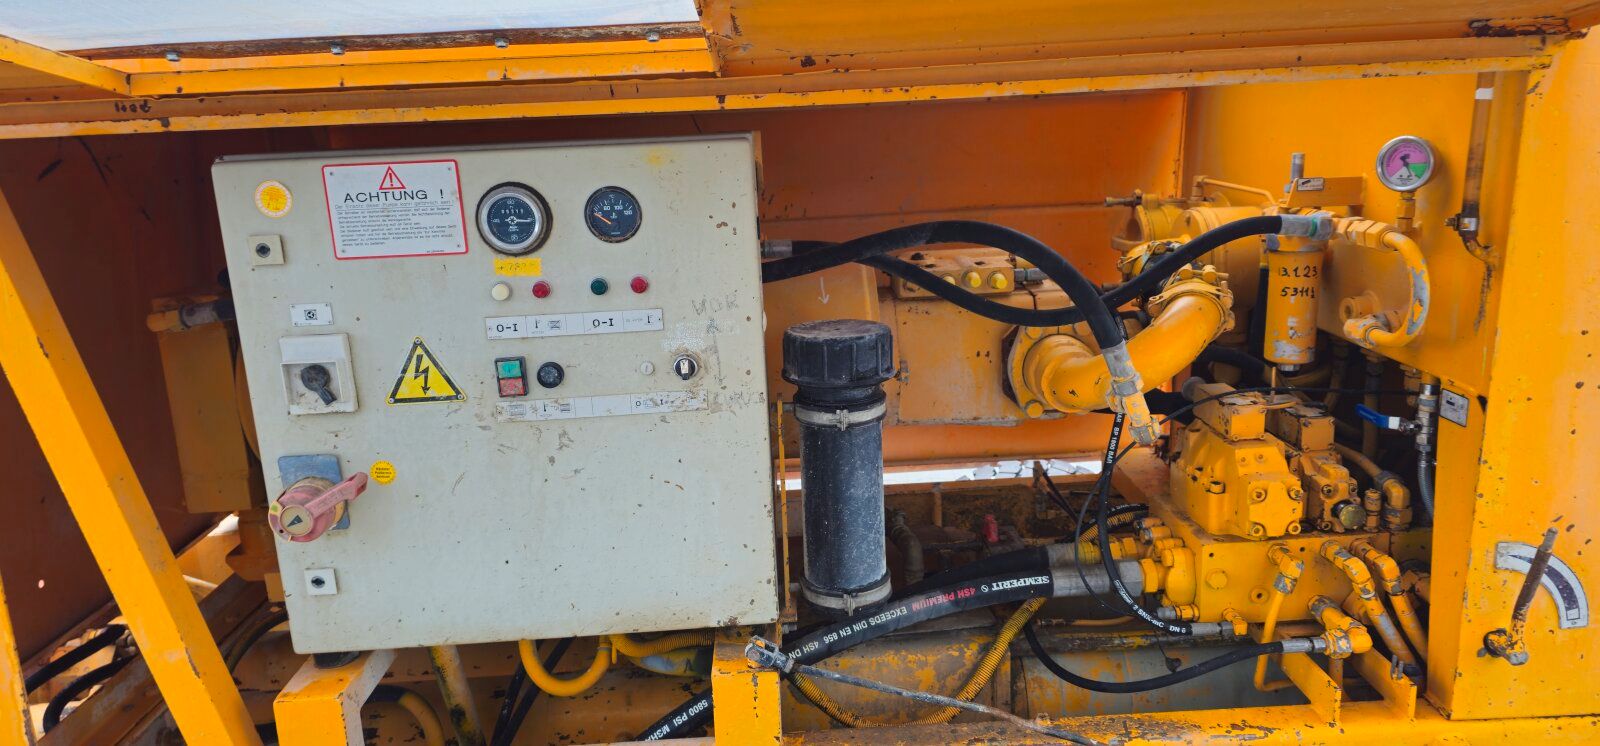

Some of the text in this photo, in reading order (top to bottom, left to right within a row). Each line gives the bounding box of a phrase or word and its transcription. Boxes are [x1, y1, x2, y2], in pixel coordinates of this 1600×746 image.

[344, 188, 444, 203] ACHTUNG !
[991, 575, 1050, 591] SEMPERIT
[957, 587, 977, 599] 4SH
[911, 592, 955, 612] PREMIUM
[868, 606, 908, 626] EXCEEDS
[840, 626, 852, 638] EN
[852, 620, 868, 632] DIN
[1169, 625, 1181, 633] DN
[823, 632, 838, 644] 856
[803, 641, 819, 654] 4SH
[688, 699, 709, 716] 5800
[672, 712, 689, 727] PSI
